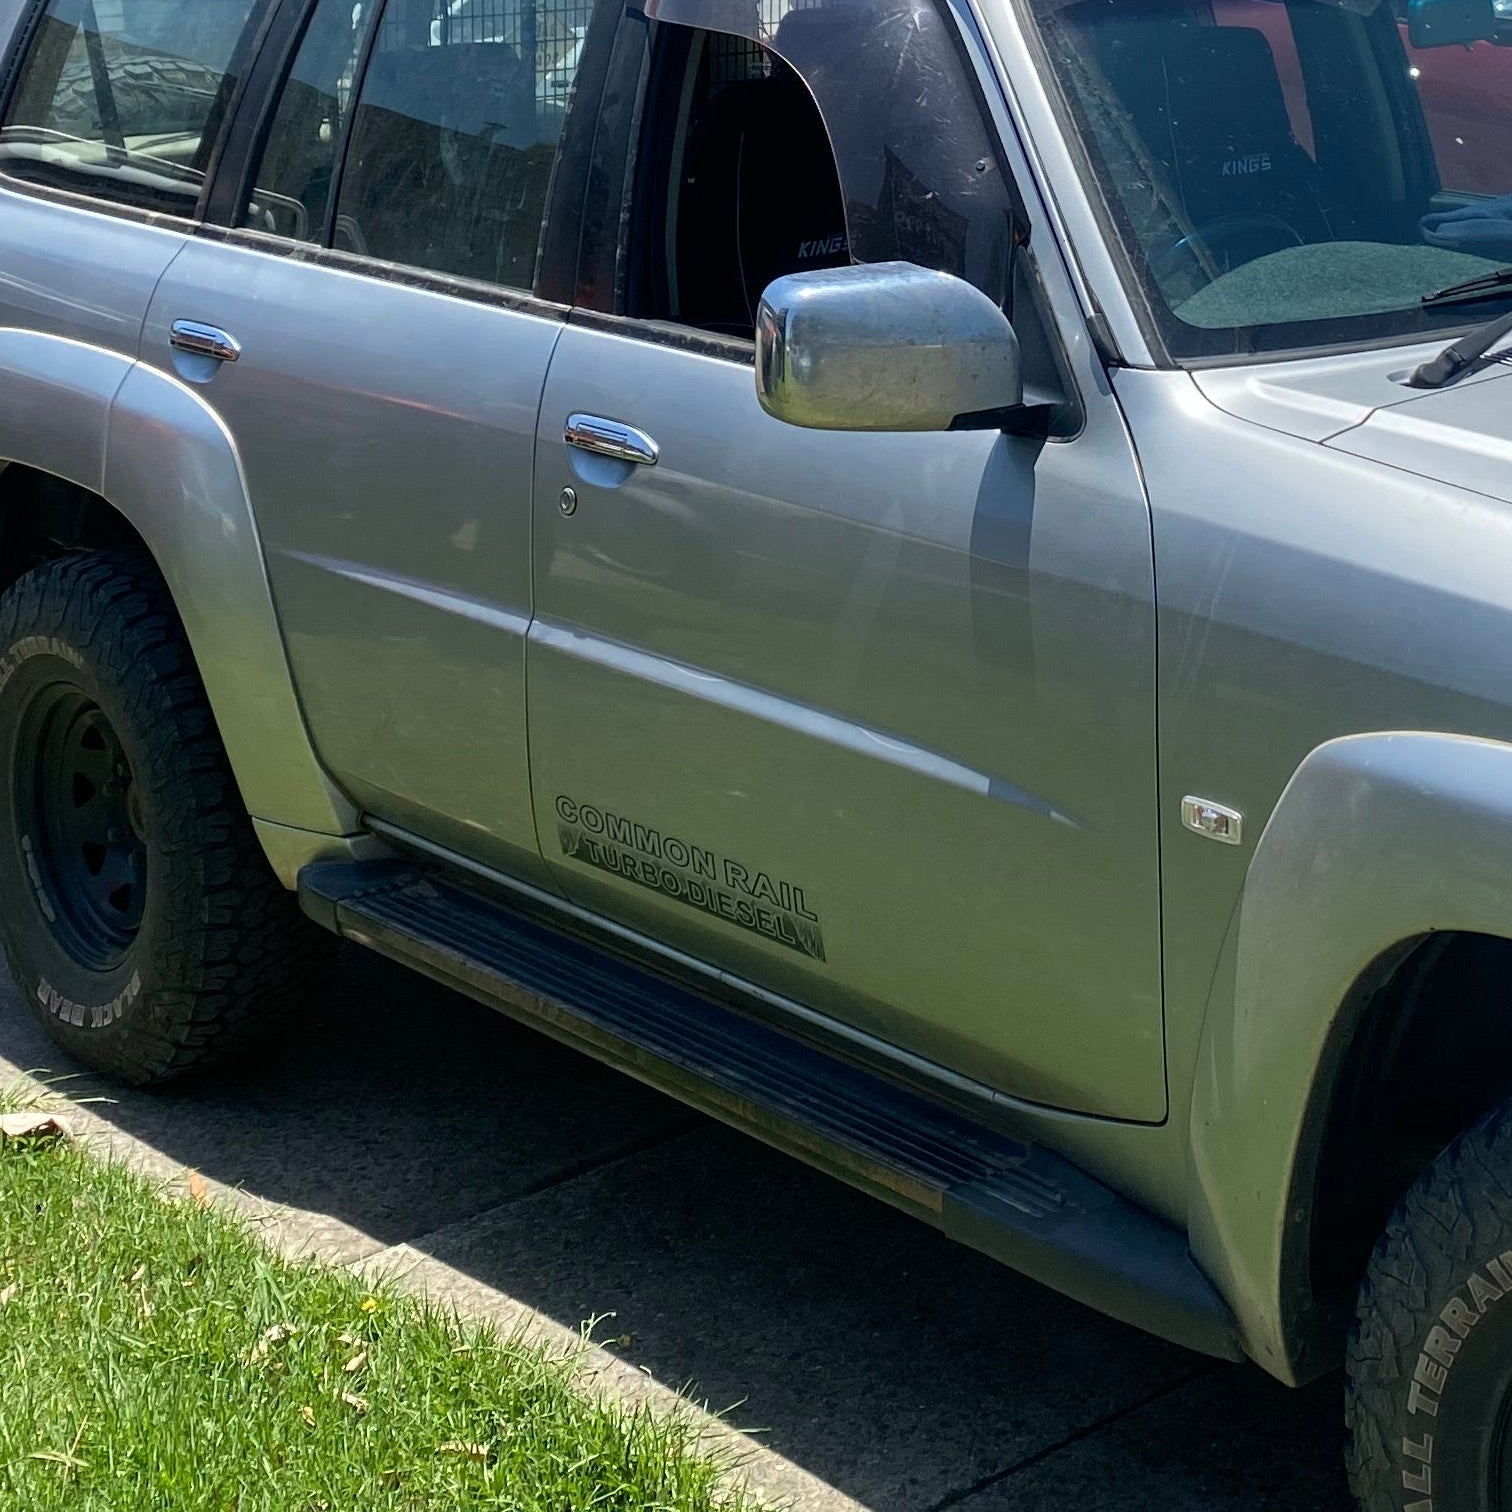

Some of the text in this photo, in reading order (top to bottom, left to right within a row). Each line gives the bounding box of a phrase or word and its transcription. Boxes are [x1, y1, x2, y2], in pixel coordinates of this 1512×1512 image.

[1222, 155, 1272, 177] KINGS
[555, 794, 818, 922] COMMON RAIL
[584, 838, 797, 945] TURBO DIESEL
